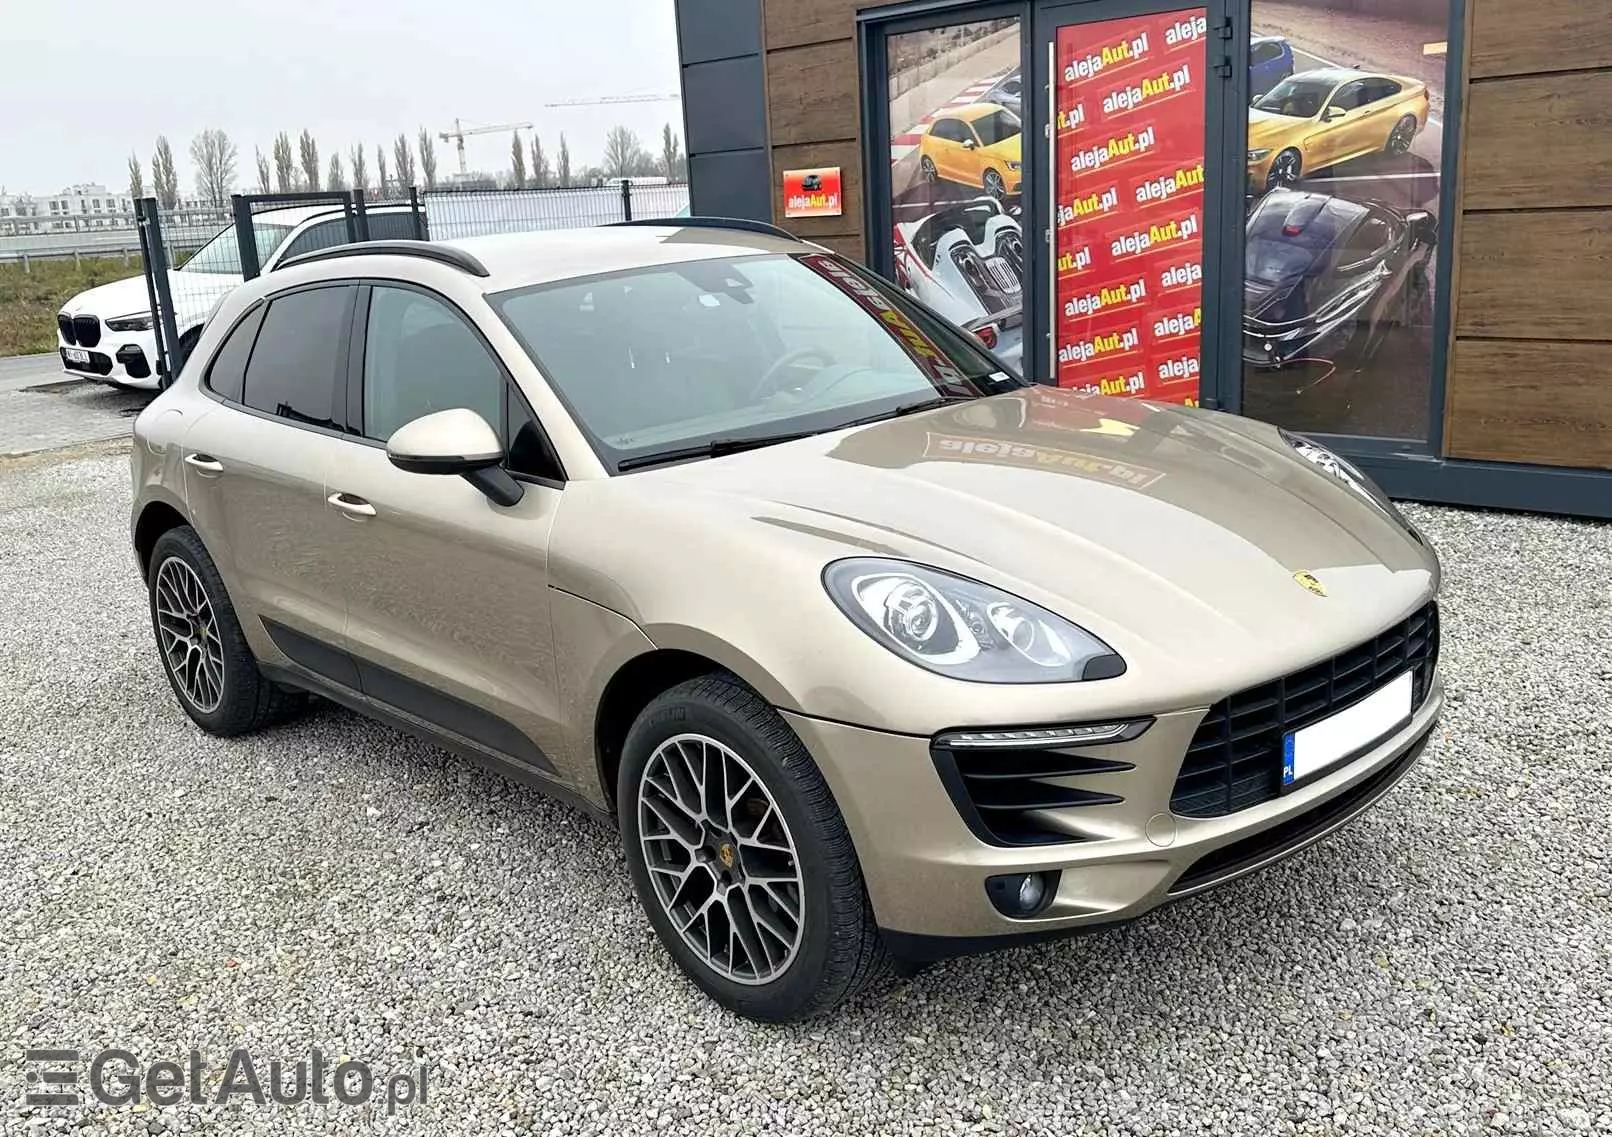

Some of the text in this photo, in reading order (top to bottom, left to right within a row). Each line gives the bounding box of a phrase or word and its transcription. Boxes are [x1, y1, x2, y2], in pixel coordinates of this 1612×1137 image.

[1064, 32, 1149, 82] alejaAut.pl
[1103, 64, 1190, 113] alejaAut.pl
[1071, 126, 1155, 172] alejaAut.pl
[788, 192, 838, 210] alejaAut.pl
[1111, 215, 1197, 256] alejaAut.pl
[1161, 262, 1201, 287] aleja
[1064, 279, 1146, 317] alejaAut.pl
[1059, 327, 1139, 363] alejaAut.pl
[1283, 764, 1293, 778] PL
